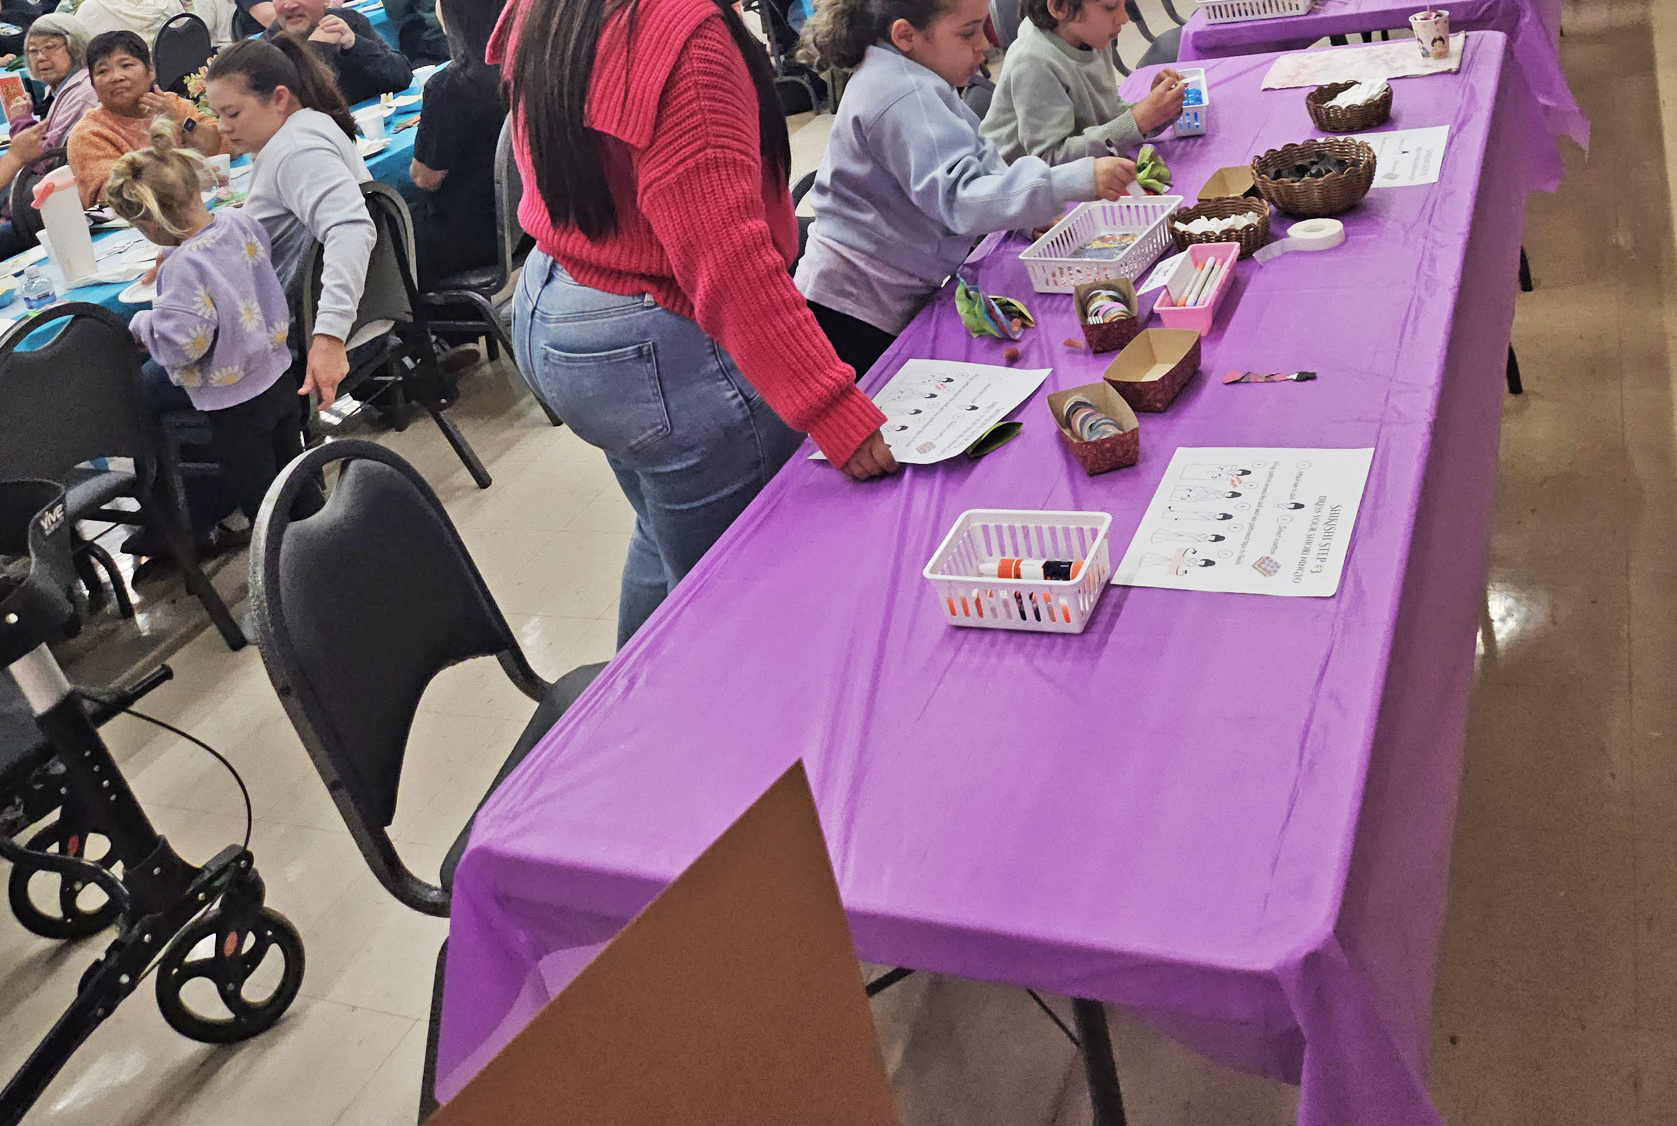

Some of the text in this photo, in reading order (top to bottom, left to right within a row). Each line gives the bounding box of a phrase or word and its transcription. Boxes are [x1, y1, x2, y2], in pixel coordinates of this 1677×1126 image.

[1314, 495, 1327, 513] DRESS
[1308, 514, 1321, 532] YOUR
[1322, 504, 1342, 540] SHIKISHI
[1316, 542, 1331, 562] STEP
